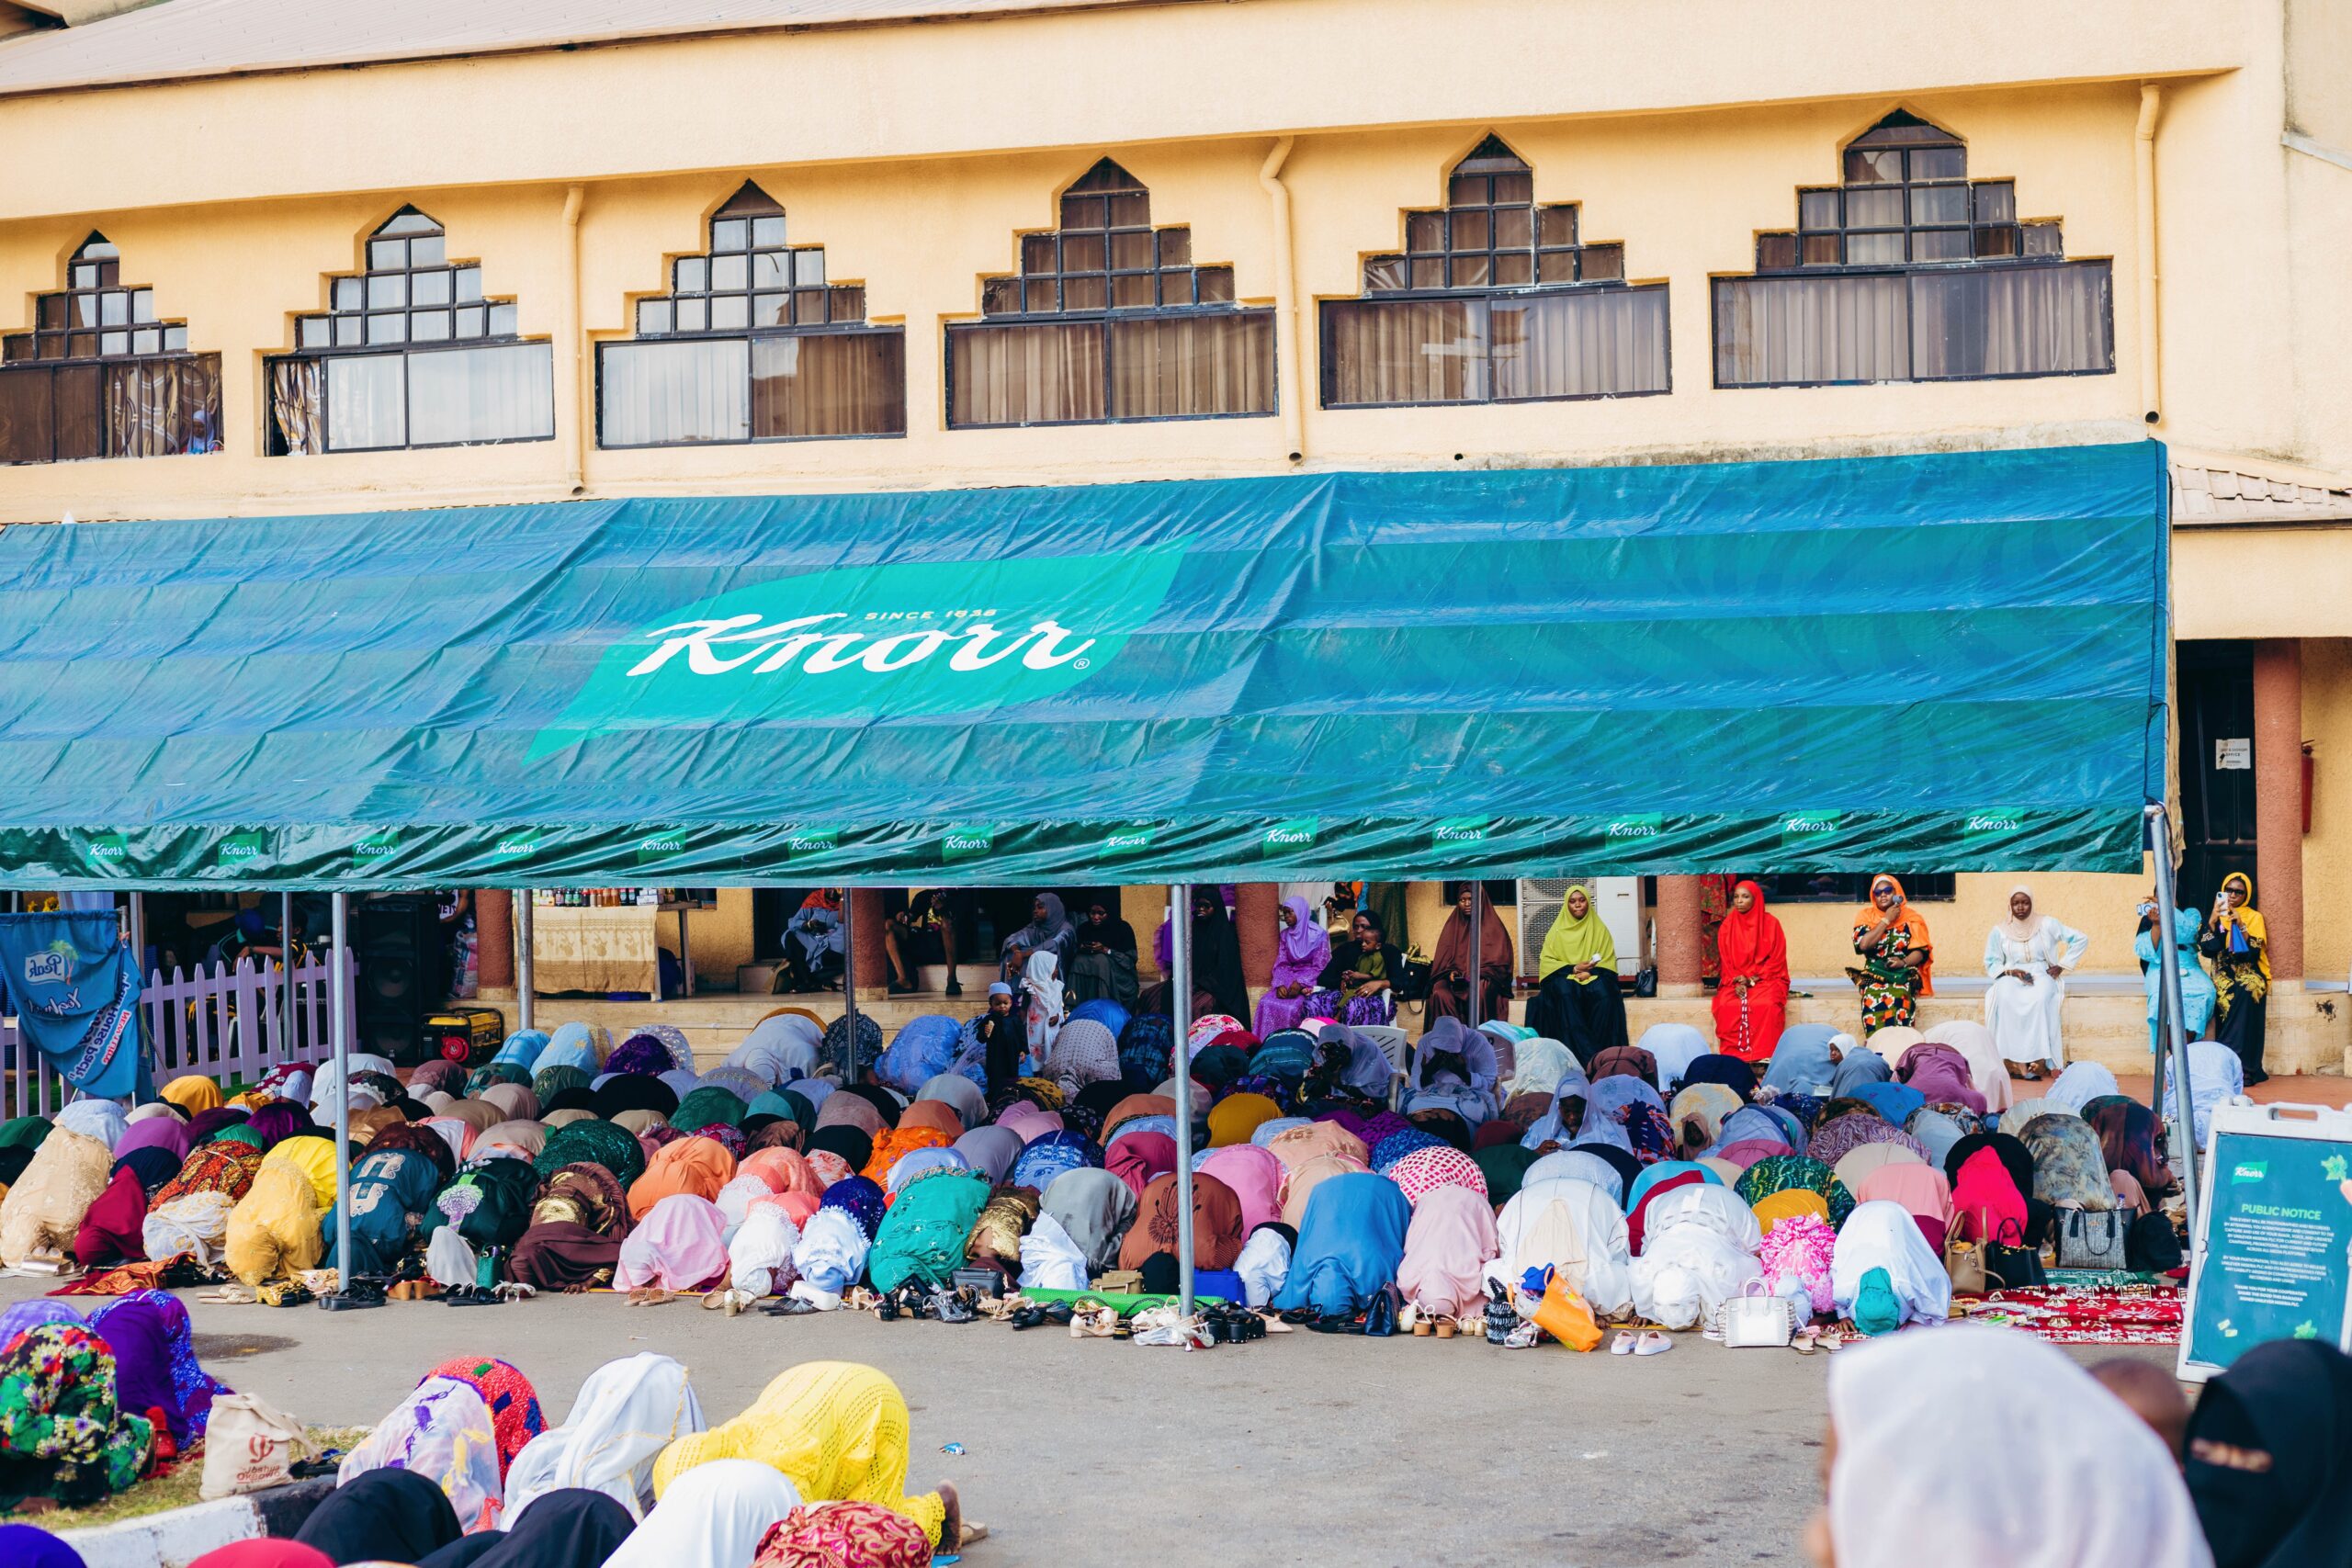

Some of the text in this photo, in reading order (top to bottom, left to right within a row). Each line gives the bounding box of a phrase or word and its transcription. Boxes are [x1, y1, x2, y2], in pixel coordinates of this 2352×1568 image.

[865, 612, 934, 620] SINCE
[626, 613, 1096, 677] Knorr
[1609, 821, 1661, 838] Knorr
[1786, 817, 1836, 832] Knorr
[1968, 814, 2019, 831] Knorr
[1267, 828, 1313, 844] Knorr
[1436, 823, 1482, 840] Knorr
[356, 841, 396, 856] Knorr
[498, 840, 536, 856] Knorr
[641, 838, 683, 852] Knorr
[791, 837, 835, 852] Knorr
[945, 835, 989, 851] Knorr
[1106, 834, 1148, 849] Knorr
[90, 843, 123, 856] Knorr
[220, 843, 257, 856] Knorr
[2235, 1168, 2264, 1178] Knorr
[2242, 1203, 2323, 1220] PUBLIC NOTICE
